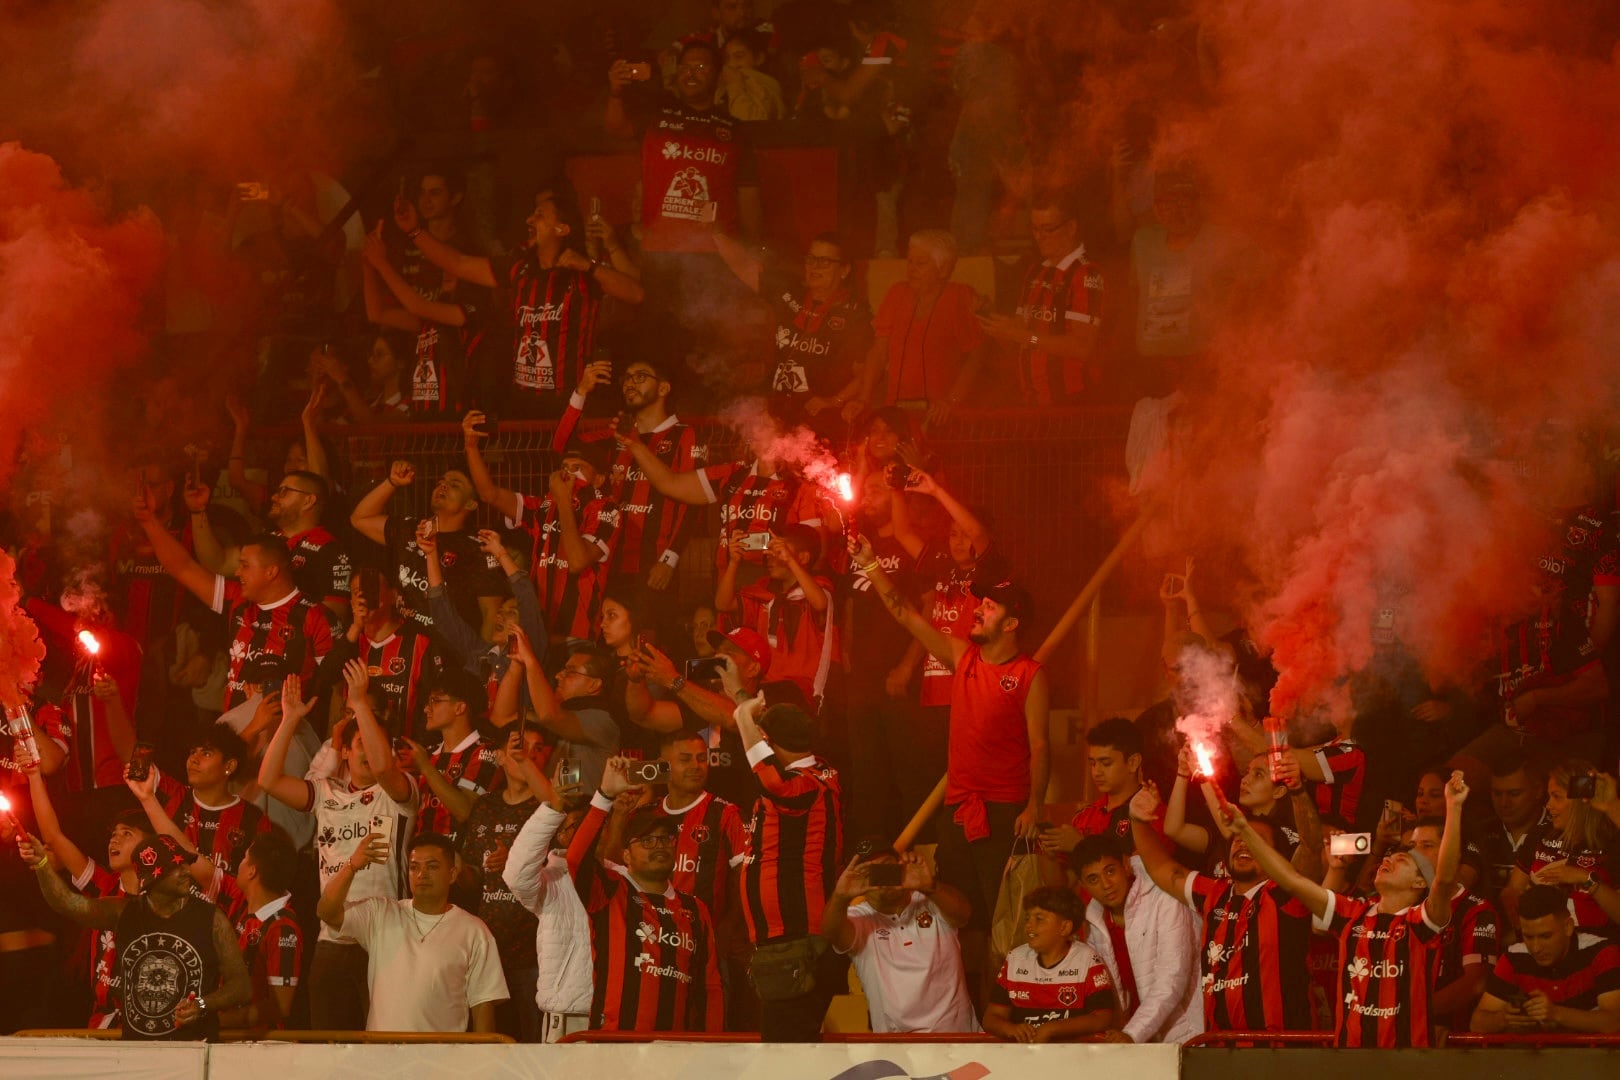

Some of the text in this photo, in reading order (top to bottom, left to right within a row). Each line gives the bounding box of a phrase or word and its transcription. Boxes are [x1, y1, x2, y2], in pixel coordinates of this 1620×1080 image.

[683, 145, 728, 165] kölbi
[664, 196, 695, 206] CEMEN
[517, 302, 564, 328] Tropical
[790, 333, 831, 356] kölbi
[514, 372, 555, 385] RTALEZA
[622, 503, 654, 515] smart
[737, 503, 778, 522] kölbi
[1538, 555, 1566, 574] ölbi
[205, 821, 220, 830] BAC
[673, 853, 702, 873] lbi
[483, 888, 522, 904] medism
[658, 926, 697, 954] kölbi
[171, 939, 201, 988] RIDER
[1058, 968, 1079, 977] Mobil
